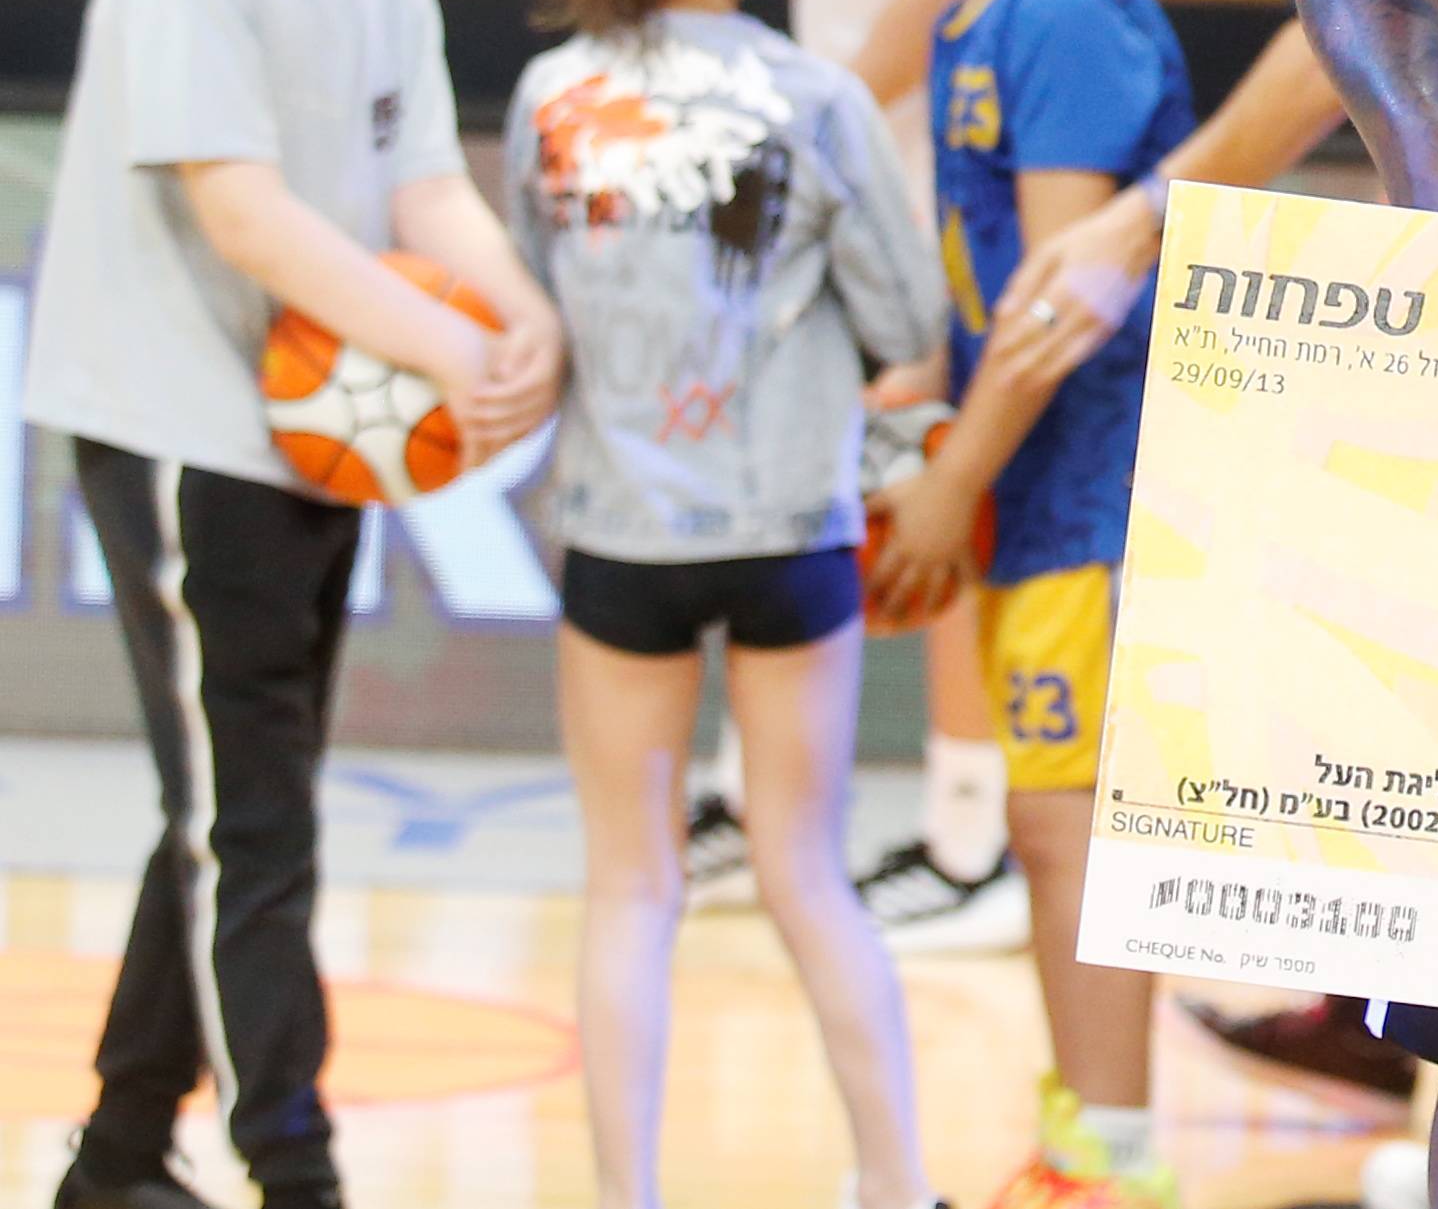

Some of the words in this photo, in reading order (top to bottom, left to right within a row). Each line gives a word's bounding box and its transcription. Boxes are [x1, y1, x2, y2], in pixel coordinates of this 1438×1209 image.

[1173, 264, 1425, 336] טפחות
[1295, 342, 1341, 366] רמת
[1383, 353, 1409, 375] 26
[1171, 361, 1284, 394] 29/09/13
[1315, 754, 1373, 790] העל
[1111, 811, 1255, 848] SIGNATURE
[1126, 939, 1196, 960] CHEQUE
[1240, 953, 1268, 969] שיק
[1274, 957, 1315, 974] מספר
